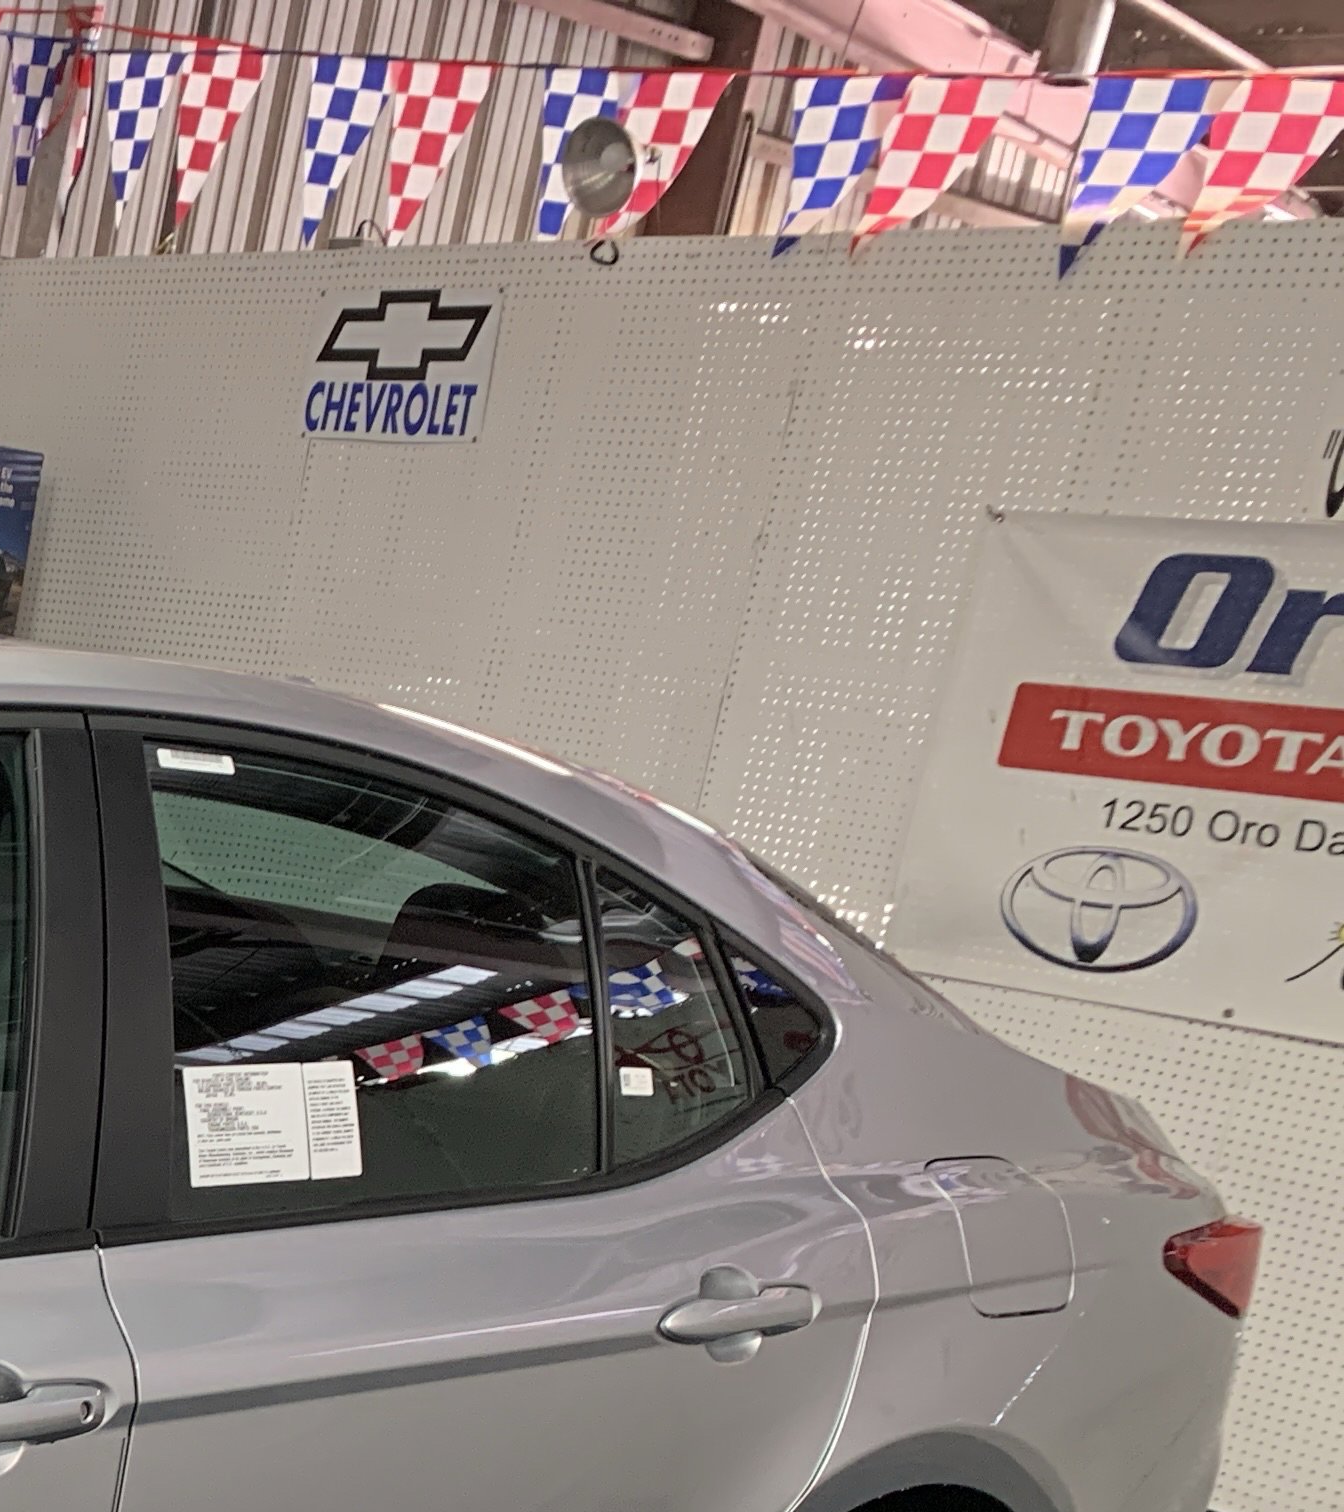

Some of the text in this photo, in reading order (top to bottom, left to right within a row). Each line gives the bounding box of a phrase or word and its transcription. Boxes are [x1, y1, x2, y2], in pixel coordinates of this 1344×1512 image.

[304, 380, 478, 437] CHEVROLET
[1102, 797, 1194, 837] 1250
[1208, 809, 1281, 848] Oro
